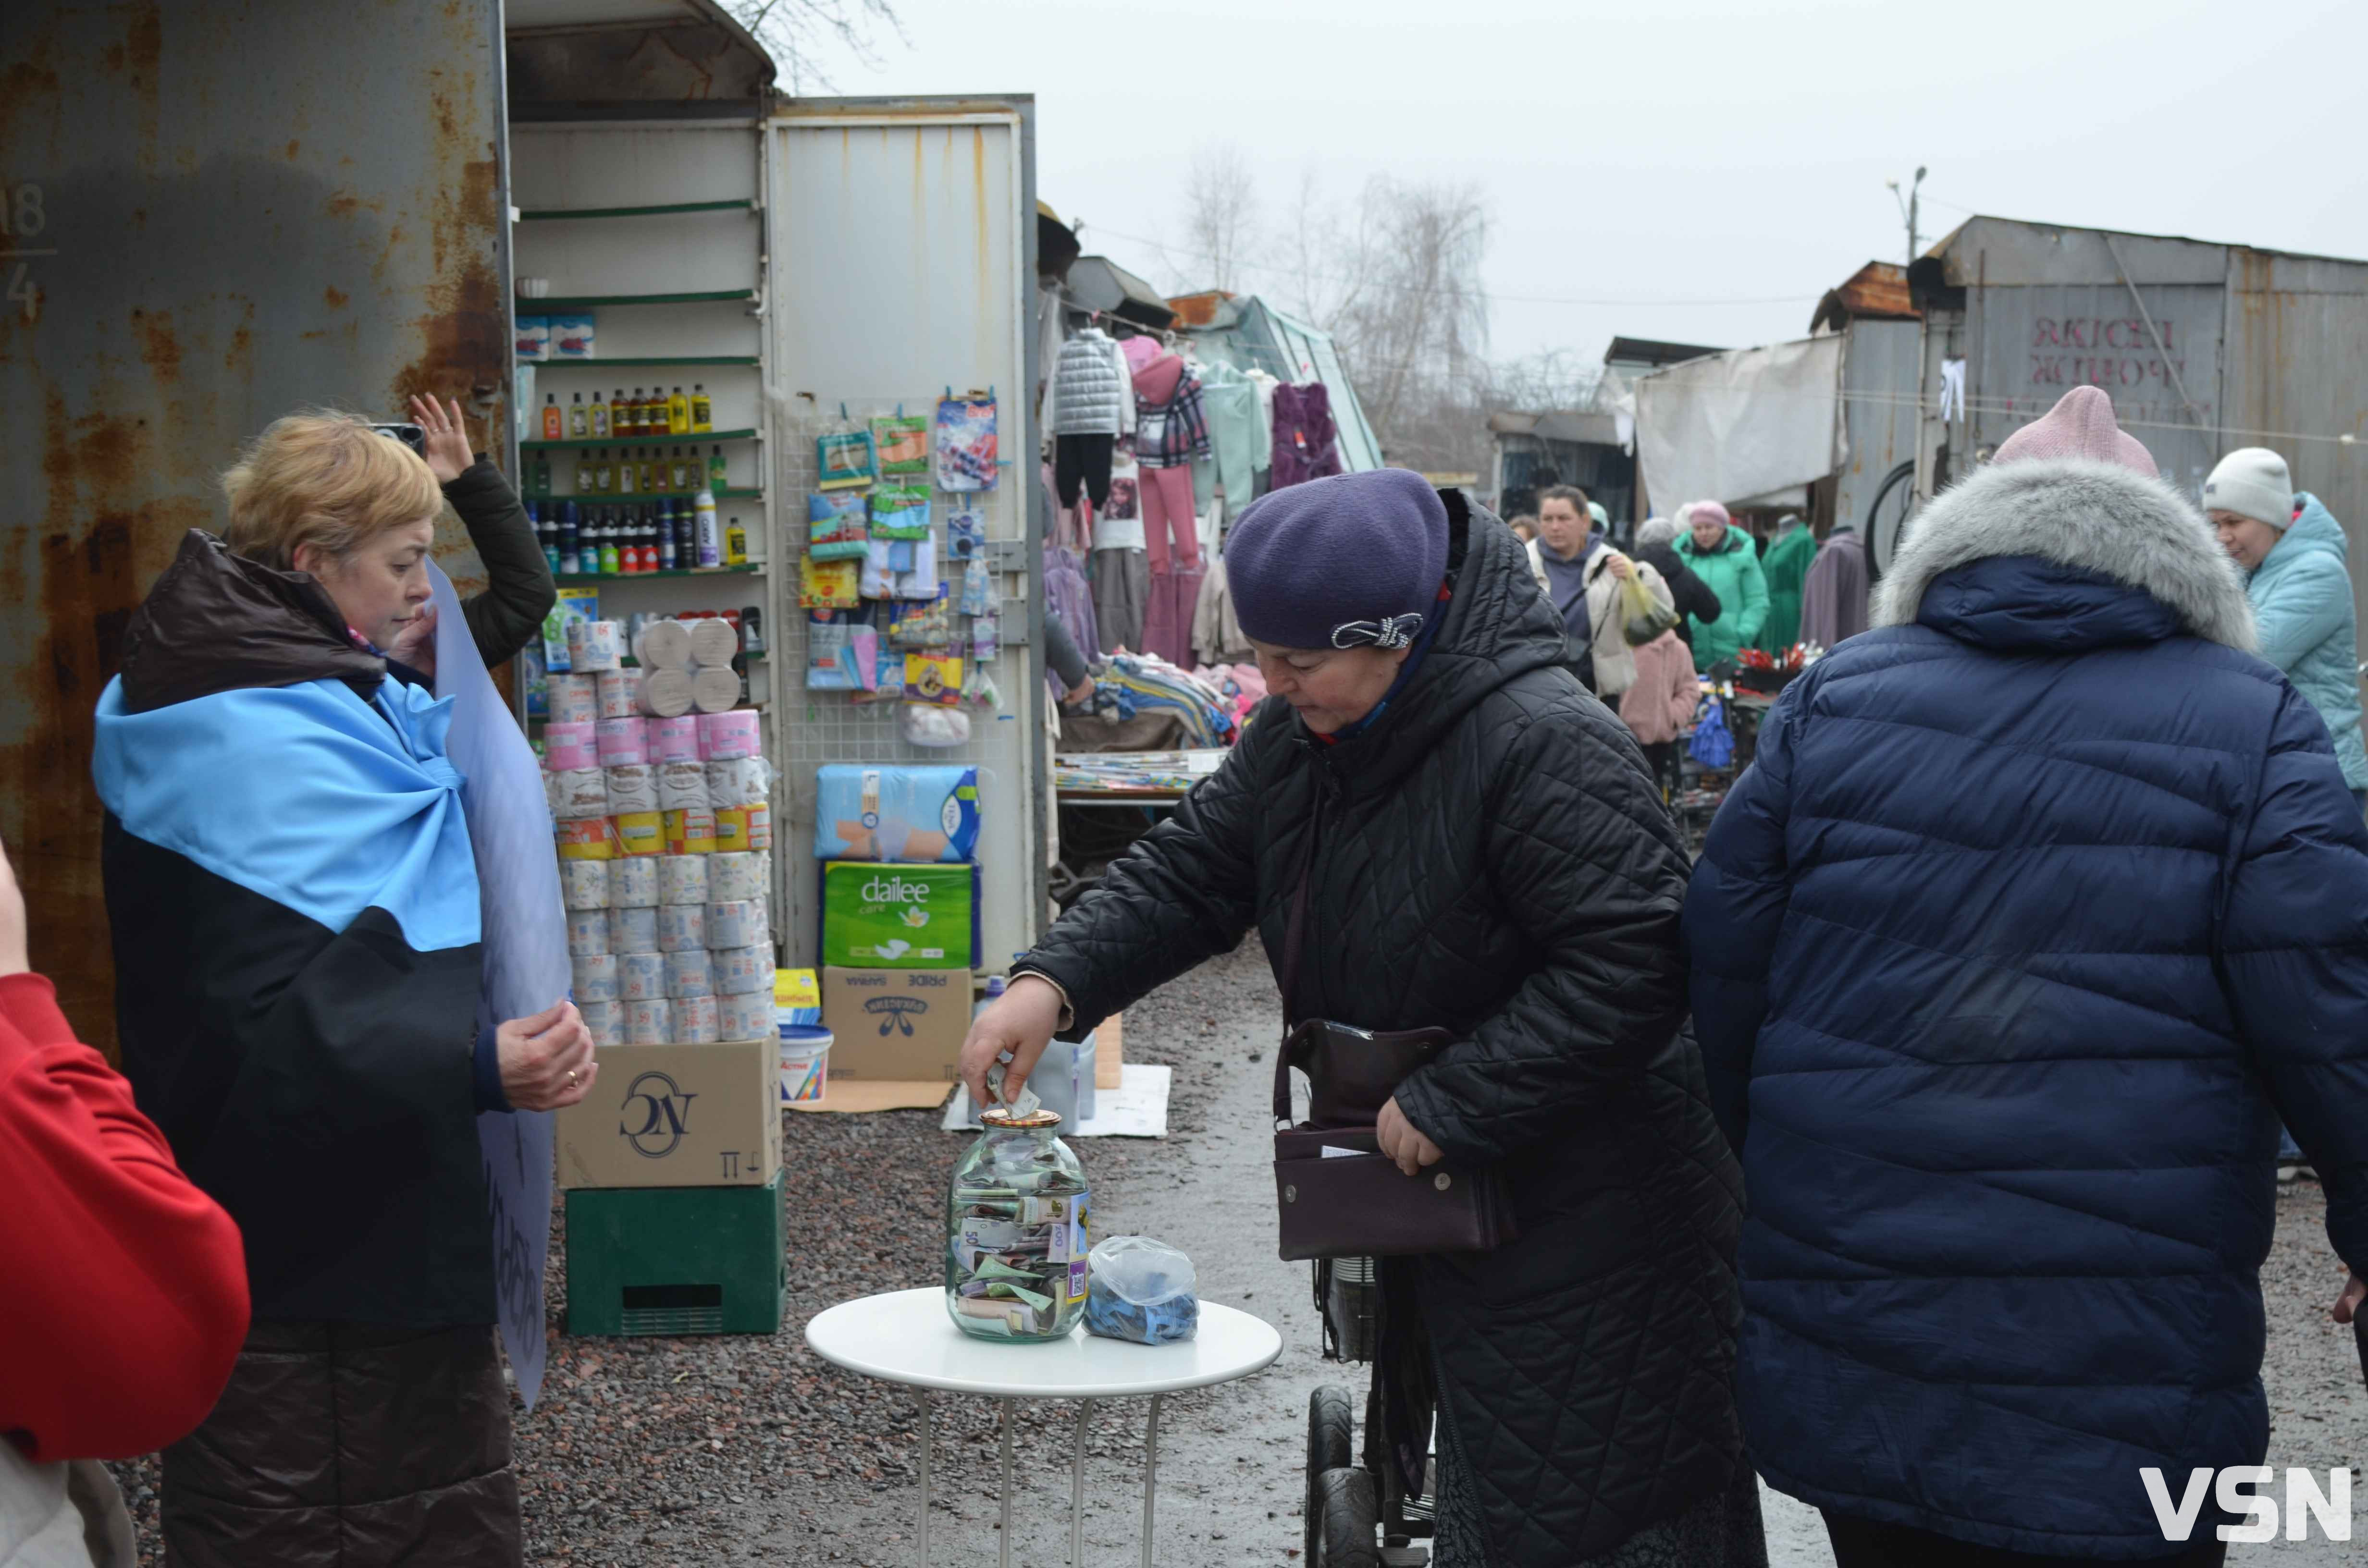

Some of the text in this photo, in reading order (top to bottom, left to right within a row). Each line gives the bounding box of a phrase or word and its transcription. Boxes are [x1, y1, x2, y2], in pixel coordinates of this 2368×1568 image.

[6, 262, 37, 322] 4
[862, 876, 930, 903] dailee
[908, 975, 947, 986] PRIDE
[965, 1230, 979, 1245] 50
